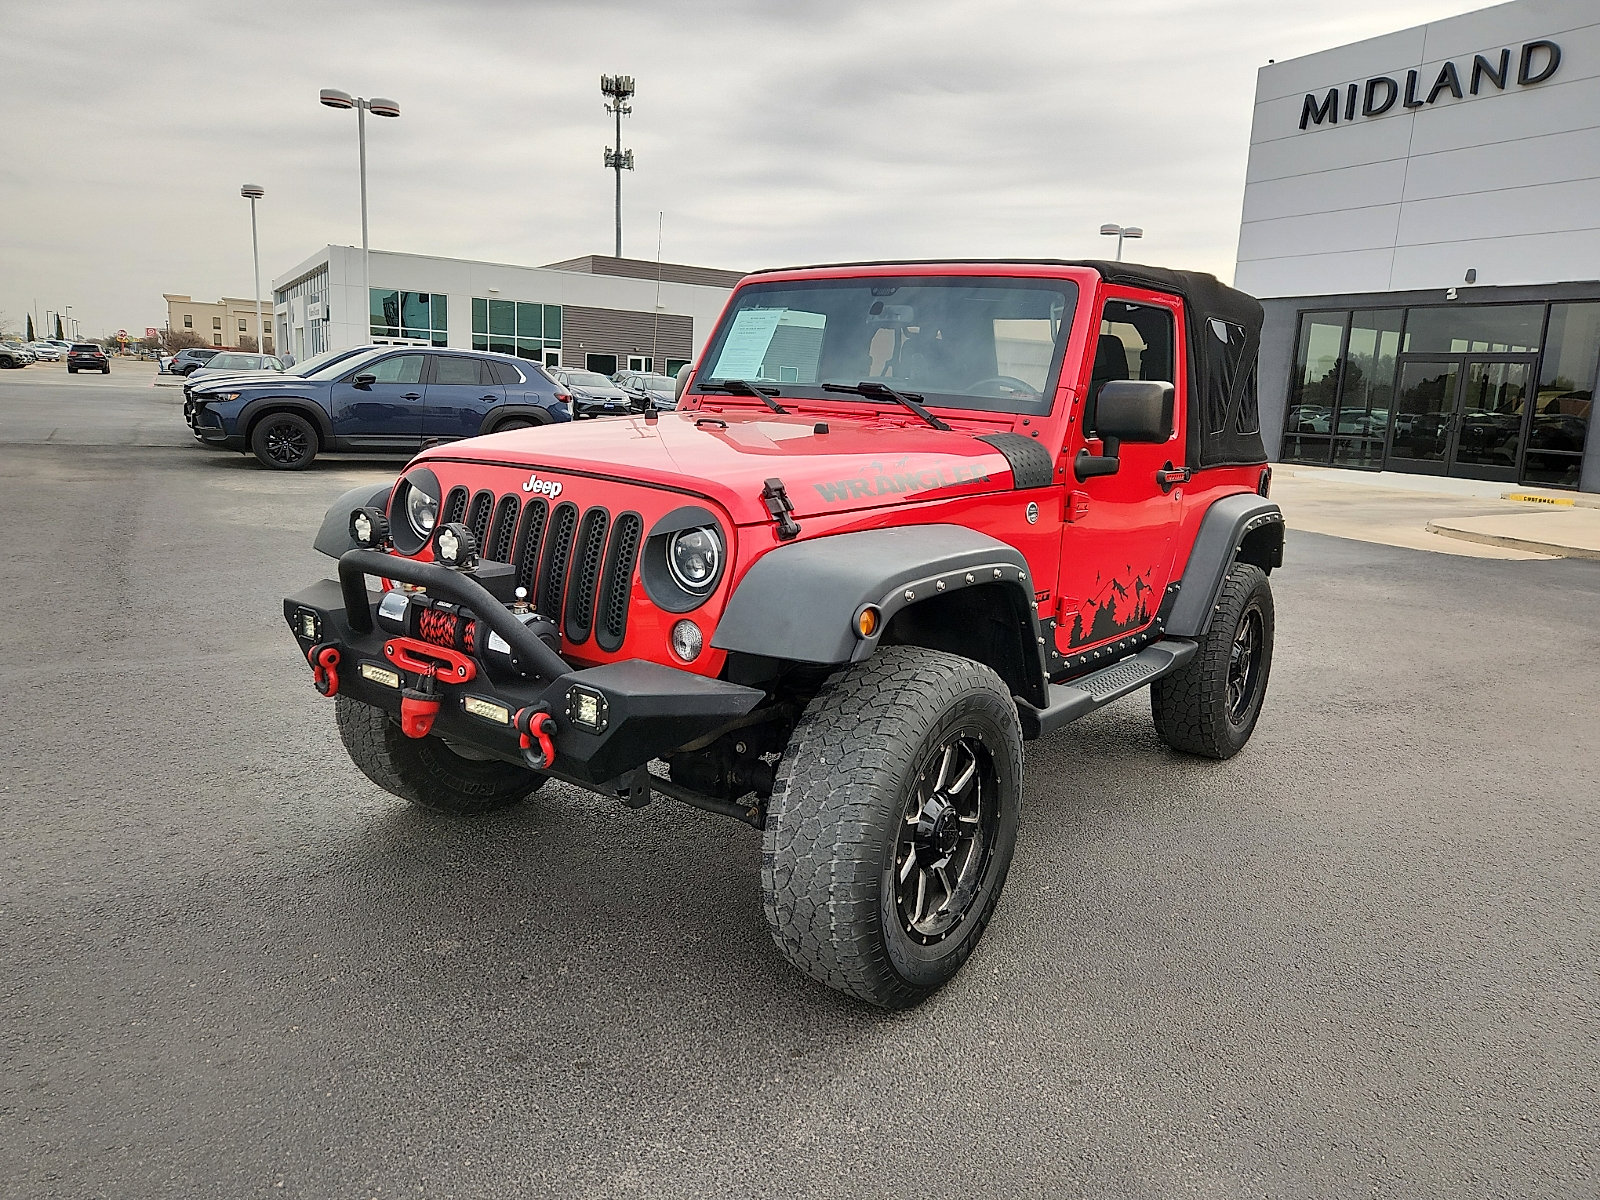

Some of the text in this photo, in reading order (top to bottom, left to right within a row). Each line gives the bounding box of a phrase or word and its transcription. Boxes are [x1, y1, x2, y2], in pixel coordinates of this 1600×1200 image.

[1299, 39, 1562, 130] MIDLAND
[1446, 287, 1458, 300] 2
[522, 474, 563, 500] Jeep
[812, 463, 991, 503] WRANGLER
[1523, 496, 1555, 505] CUSTOMER
